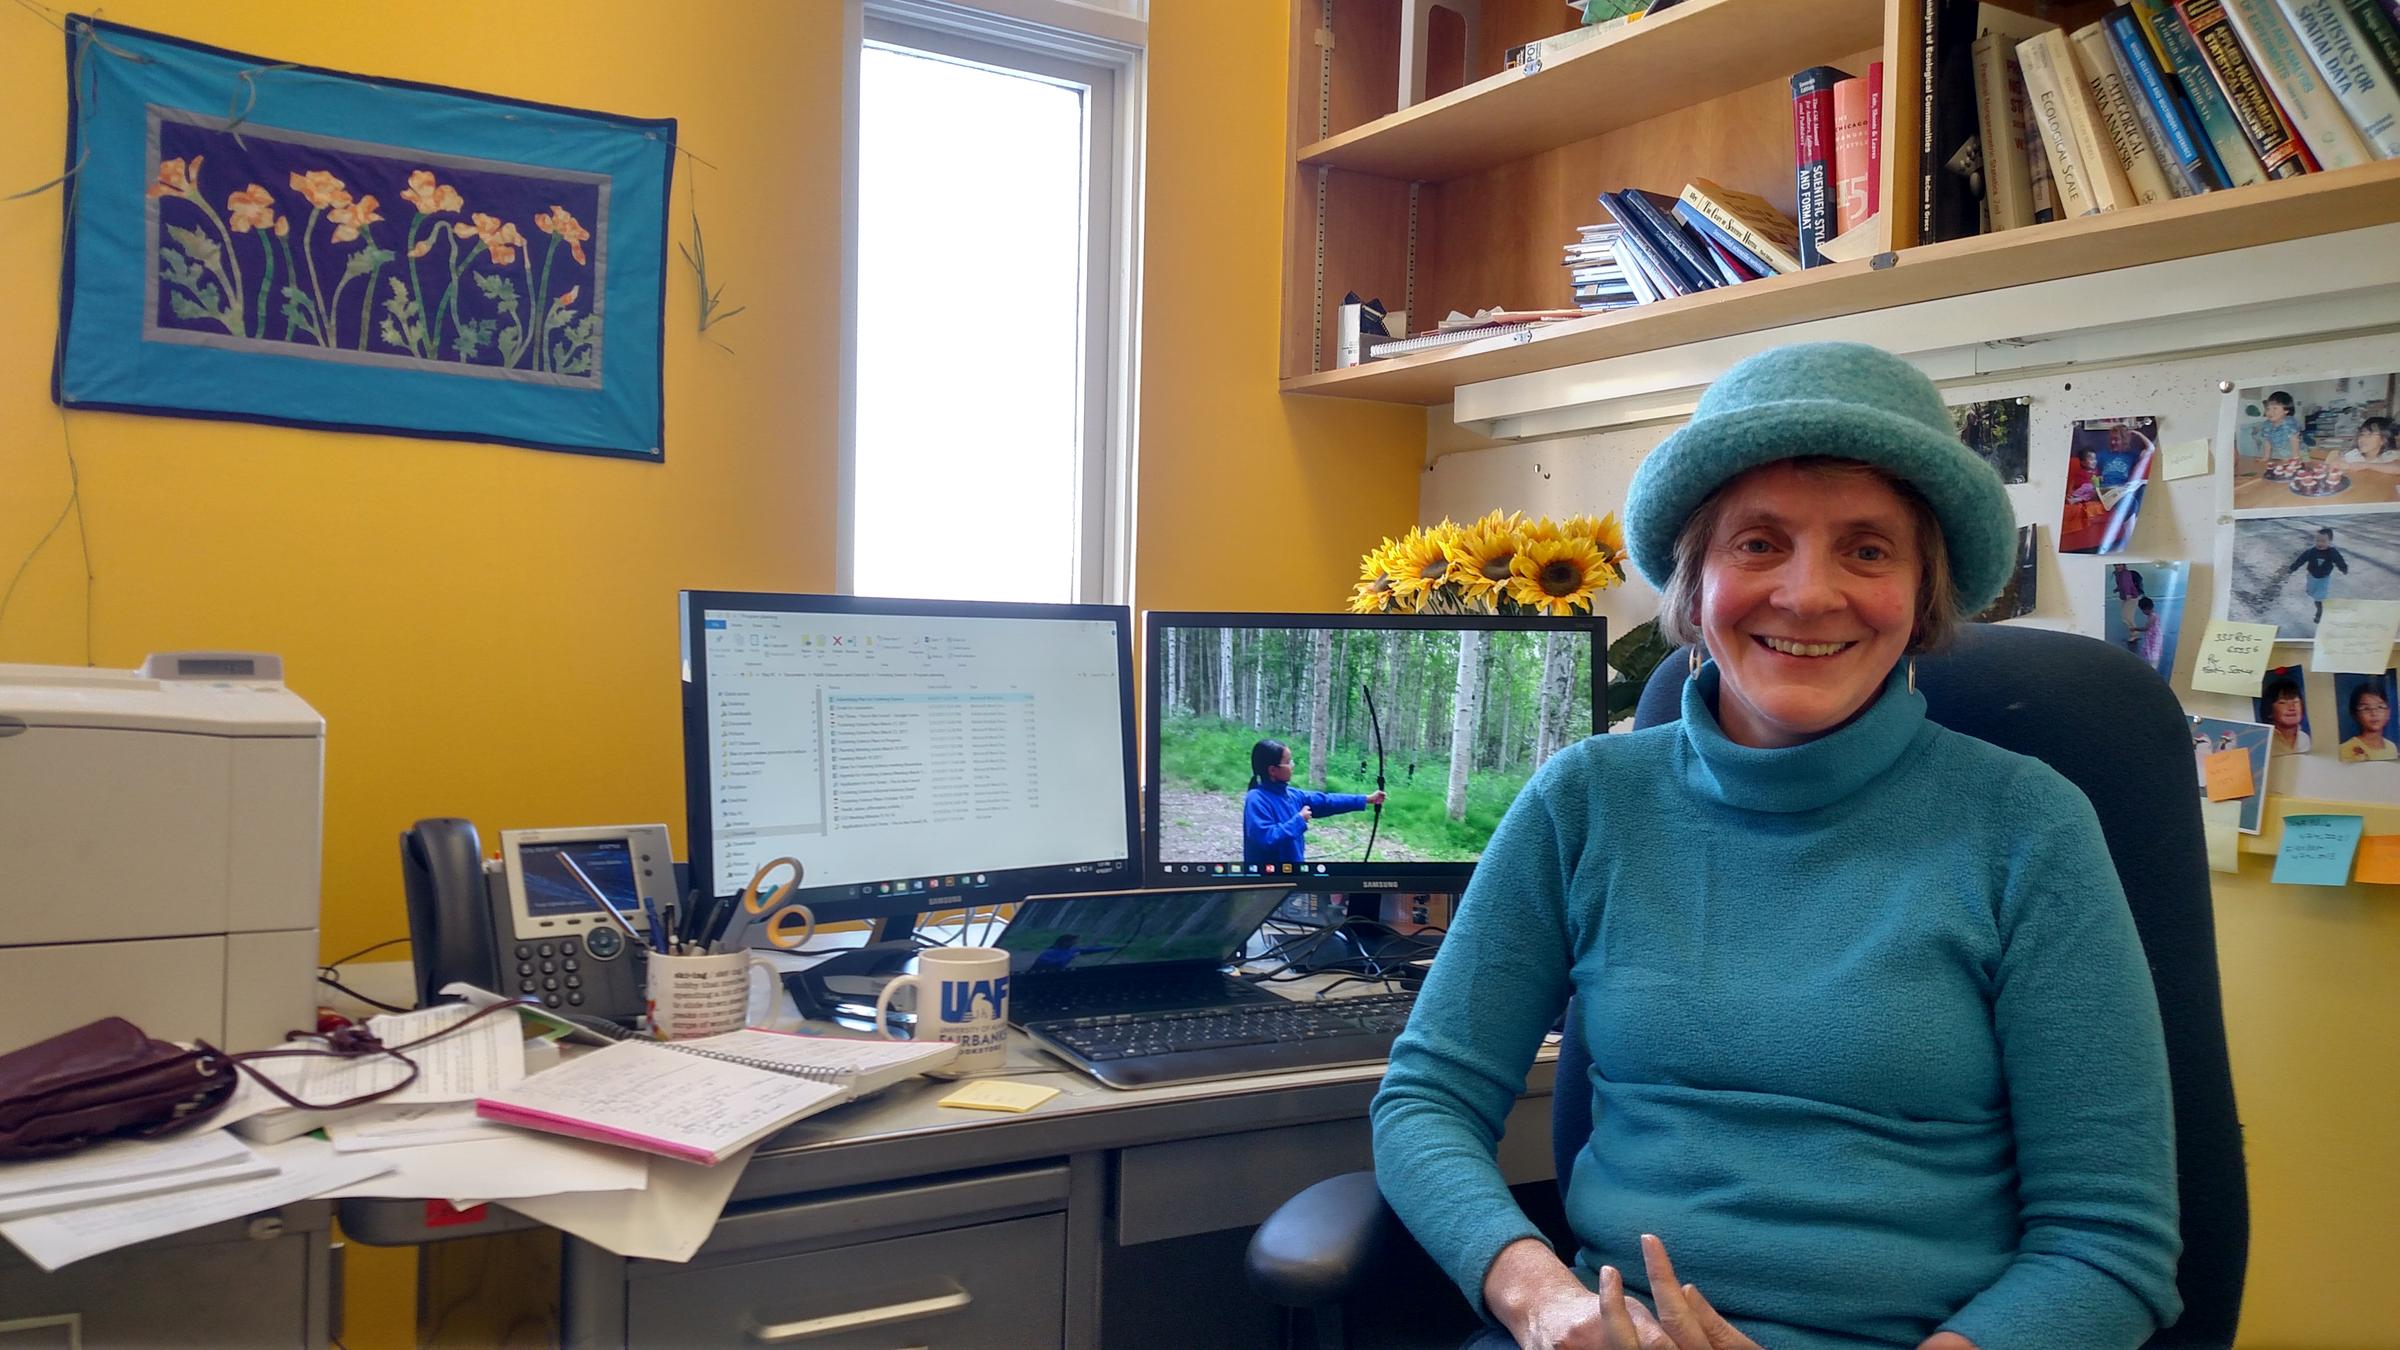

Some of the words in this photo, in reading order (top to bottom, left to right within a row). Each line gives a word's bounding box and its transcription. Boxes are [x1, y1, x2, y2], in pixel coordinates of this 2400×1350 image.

[1924, 0, 1936, 33] nalysis
[1926, 35, 1935, 45] of
[1924, 46, 1935, 92] Ecological
[2294, 5, 2334, 58] SPATIAL
[2324, 57, 2355, 96] DATA
[2201, 32, 2244, 94] STATISTICAL
[2233, 91, 2268, 140] ANALYSIS
[2212, 24, 2245, 67] APPLIED
[2232, 64, 2281, 135] MULTIVARIATE
[2348, 63, 2376, 95] FOR
[1835, 120, 1869, 133] CHICAGO
[1925, 94, 1934, 153] Communities
[2089, 77, 2111, 111] DATA
[2103, 111, 2136, 171] ANALYSIS
[2104, 72, 2146, 159] CATEGORICAL
[2040, 90, 2069, 165] ECOLOGICAL
[2062, 165, 2080, 202] SCALE
[1799, 170, 1810, 191] AND
[1813, 165, 1824, 218] SCIENTIFIC
[1800, 192, 1811, 230] FORMAT
[1815, 220, 1825, 248] STYLE
[941, 976, 1009, 1023] UAF
